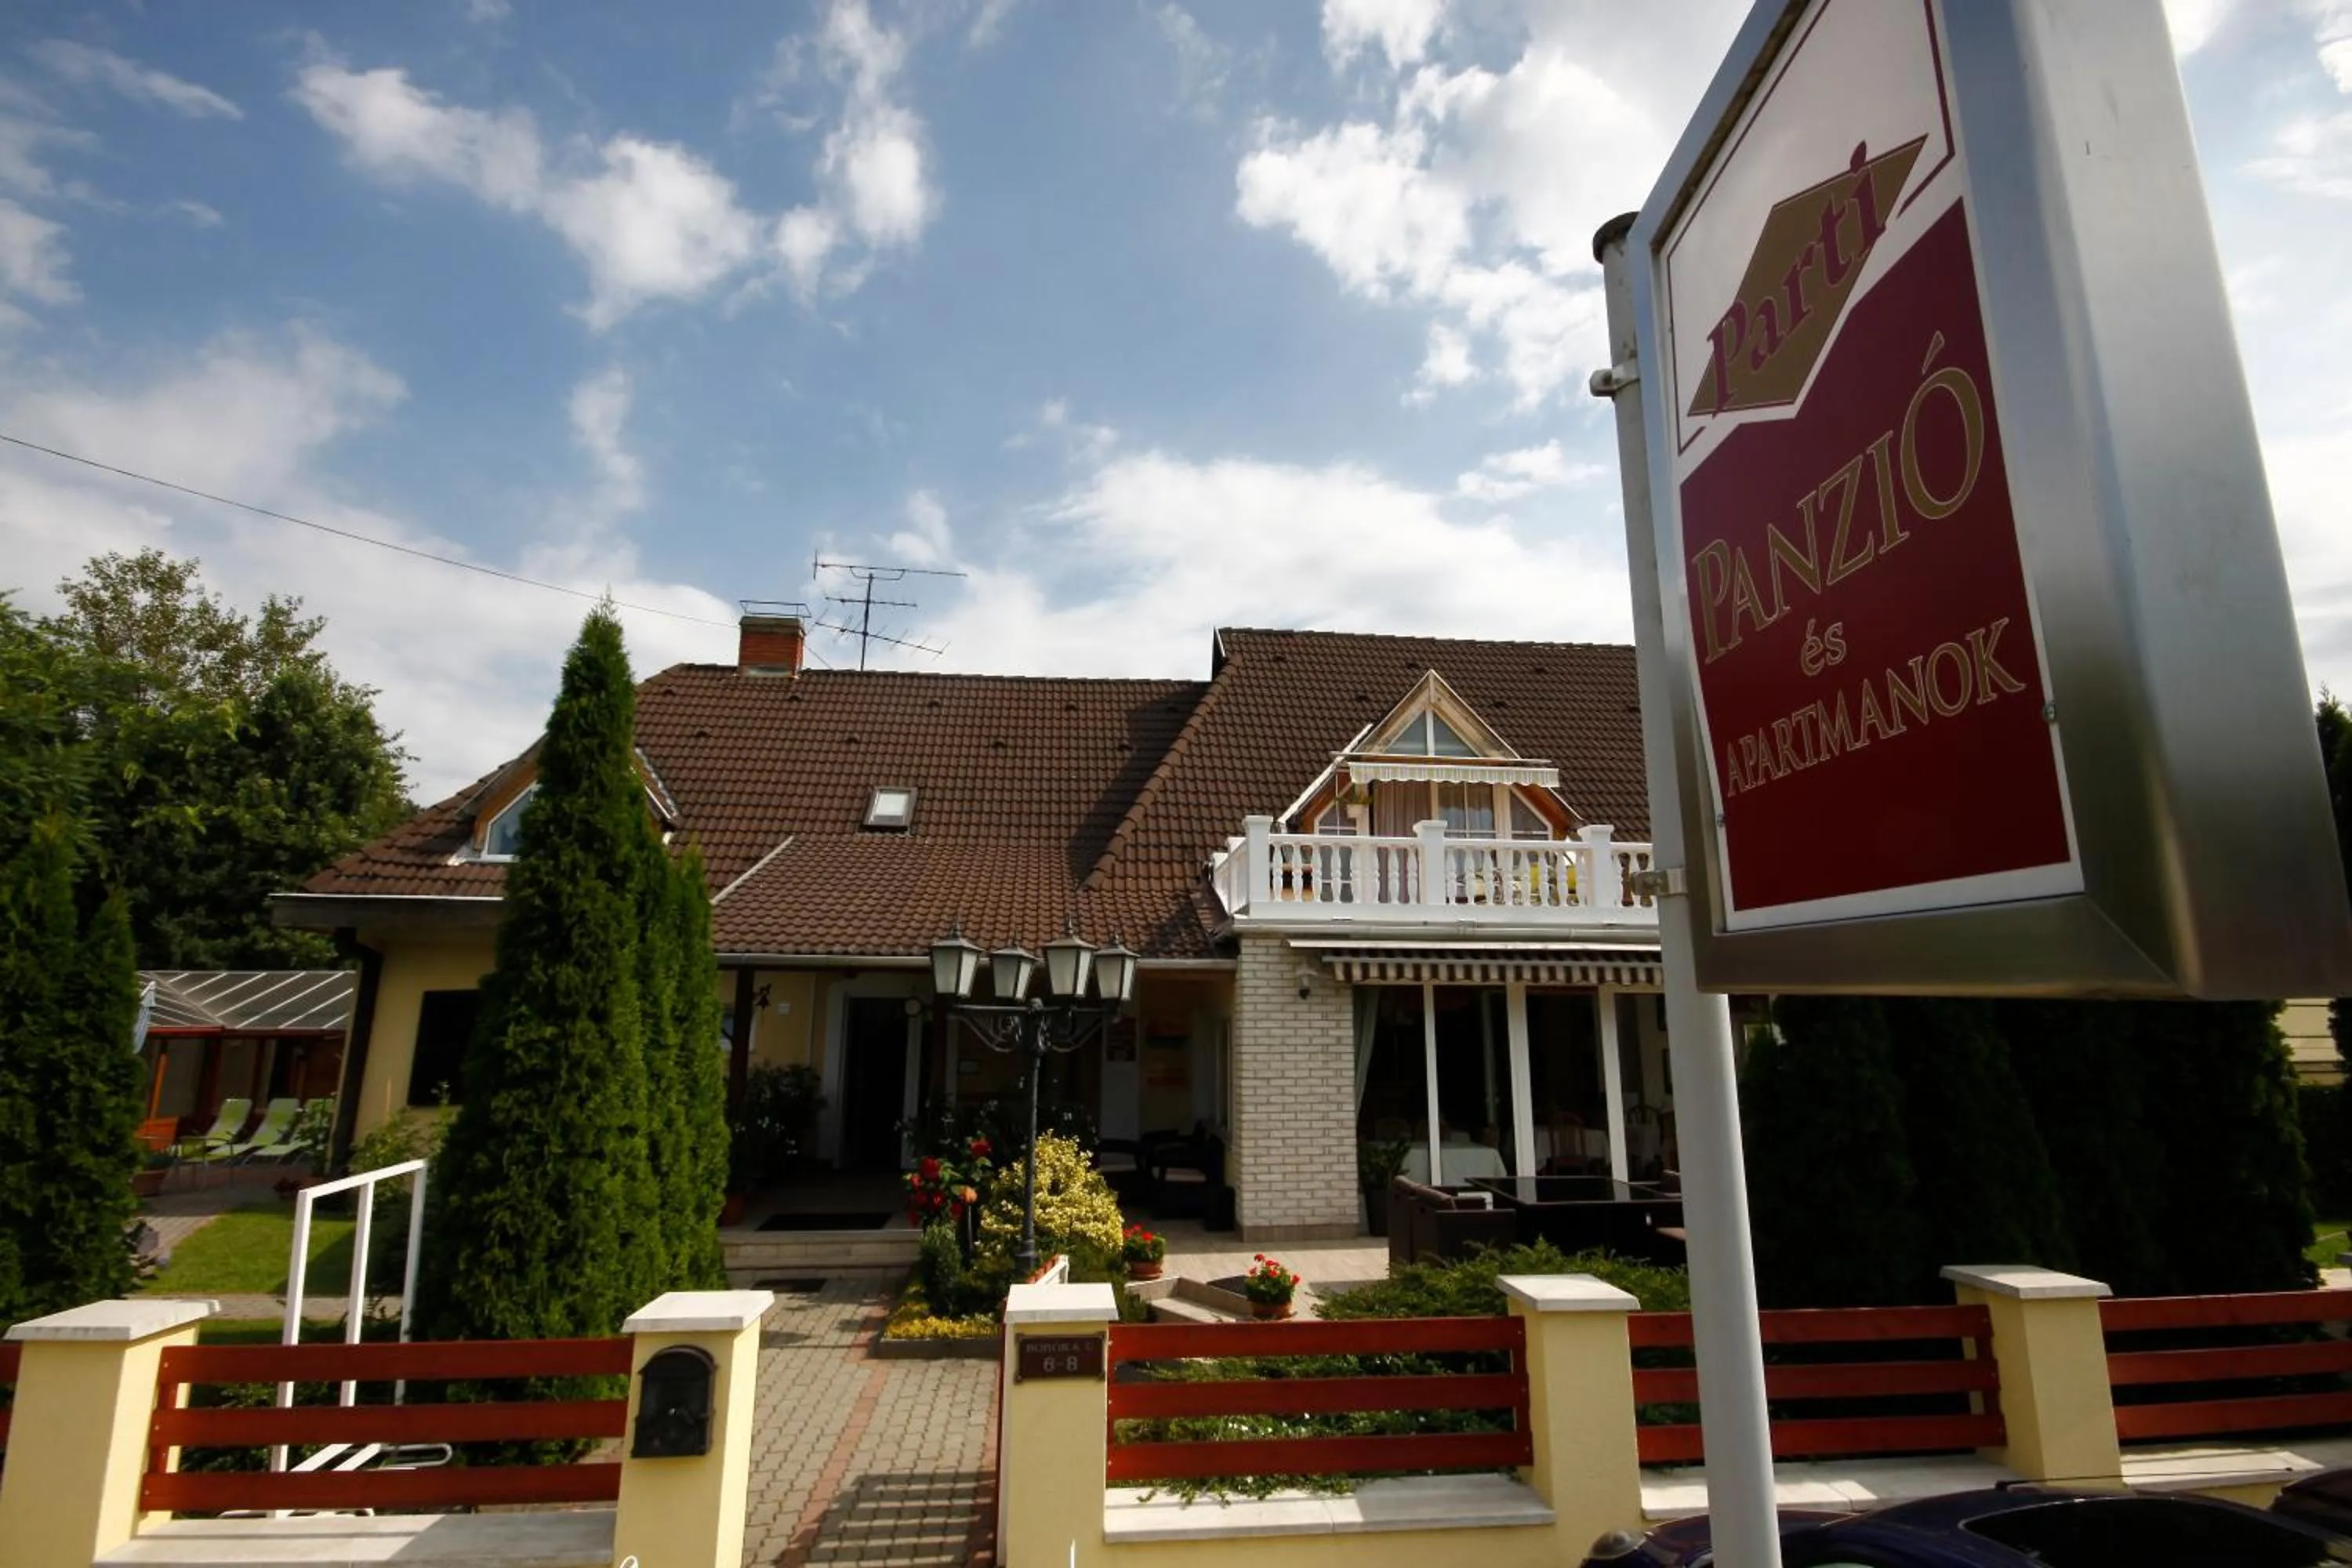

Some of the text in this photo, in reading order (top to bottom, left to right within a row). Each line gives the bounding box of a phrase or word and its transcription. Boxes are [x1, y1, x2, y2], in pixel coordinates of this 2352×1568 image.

[1706, 140, 1886, 420] Parti
[1691, 330, 1984, 665] PANZIÓ
[1726, 617, 2027, 797] APARTMANOK
[1800, 618, 1848, 677] és
